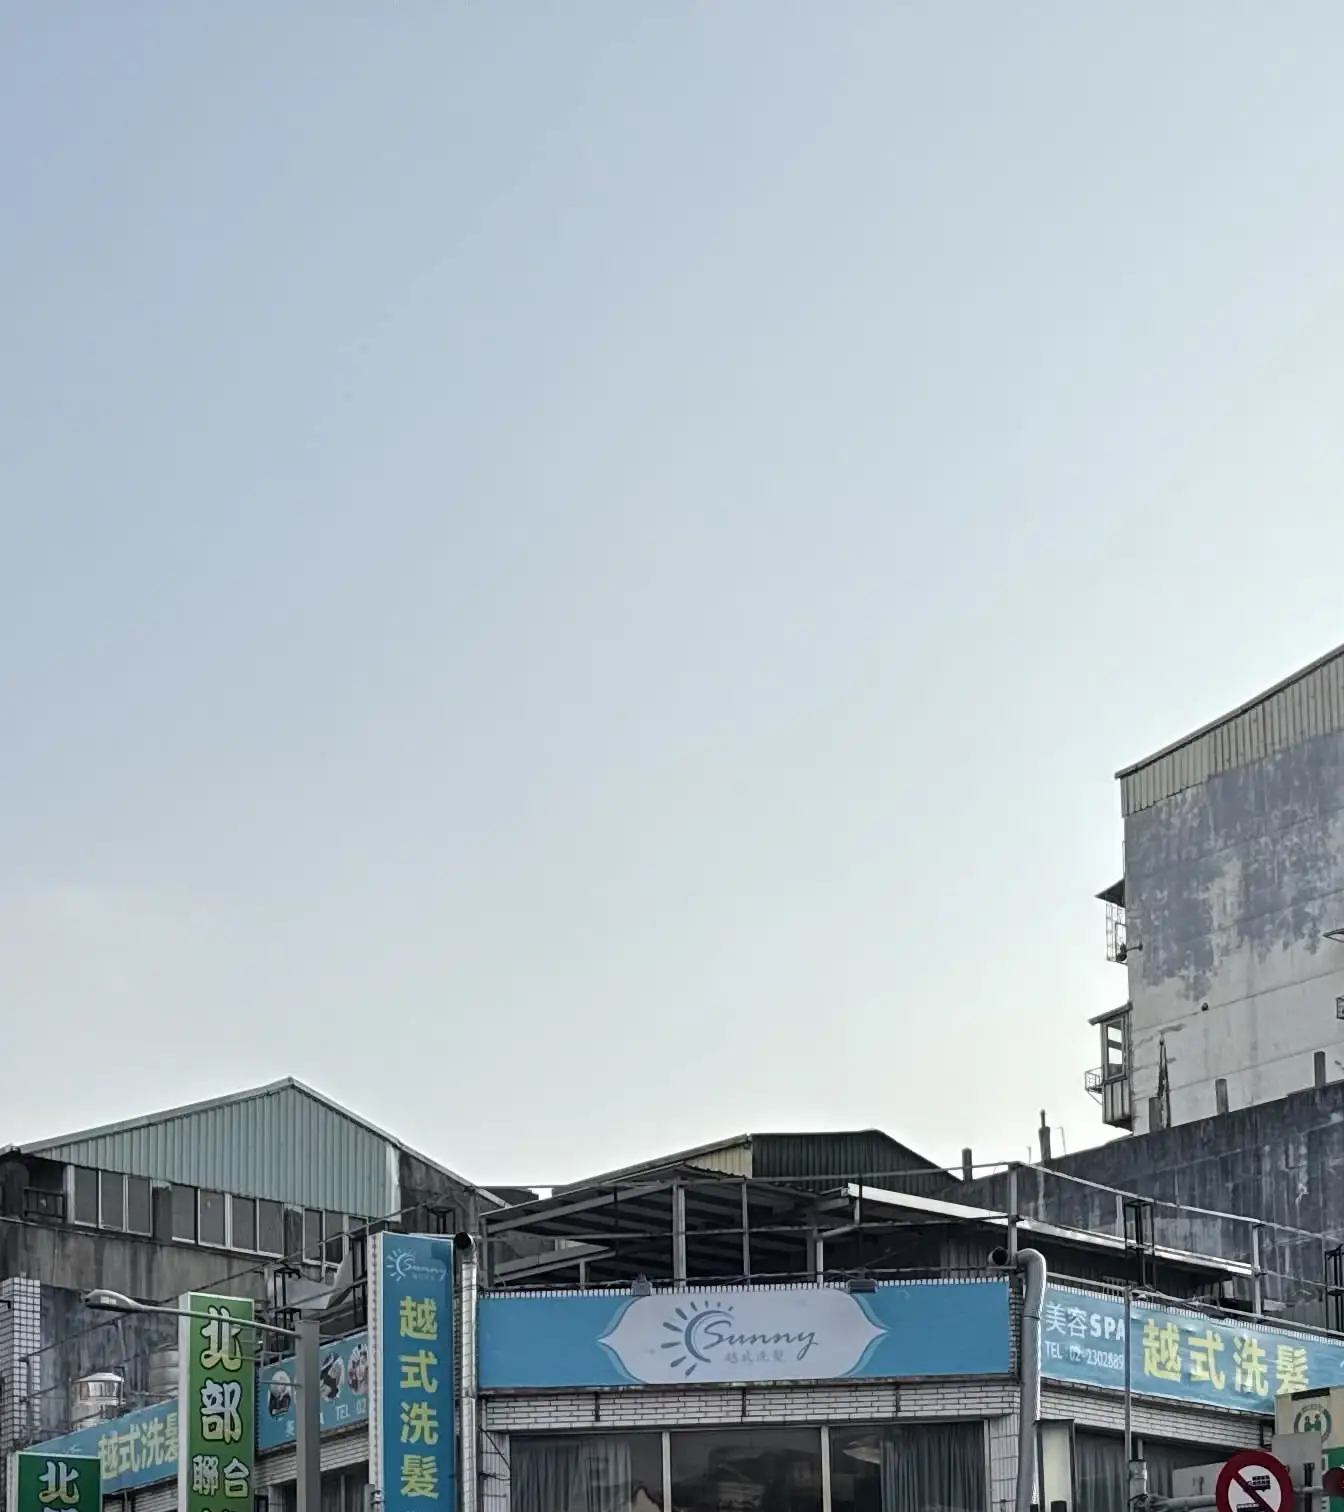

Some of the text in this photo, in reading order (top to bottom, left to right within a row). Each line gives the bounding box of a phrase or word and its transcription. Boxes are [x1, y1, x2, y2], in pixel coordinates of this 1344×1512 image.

[403, 1256, 447, 1282] Sunny
[703, 1320, 819, 1361] Sunny
[1044, 1301, 1126, 1341] 美容SPA
[1045, 1341, 1063, 1360] TEL
[1142, 1318, 1310, 1397] 越式洗髮
[399, 1296, 439, 1500] 越式洗髮
